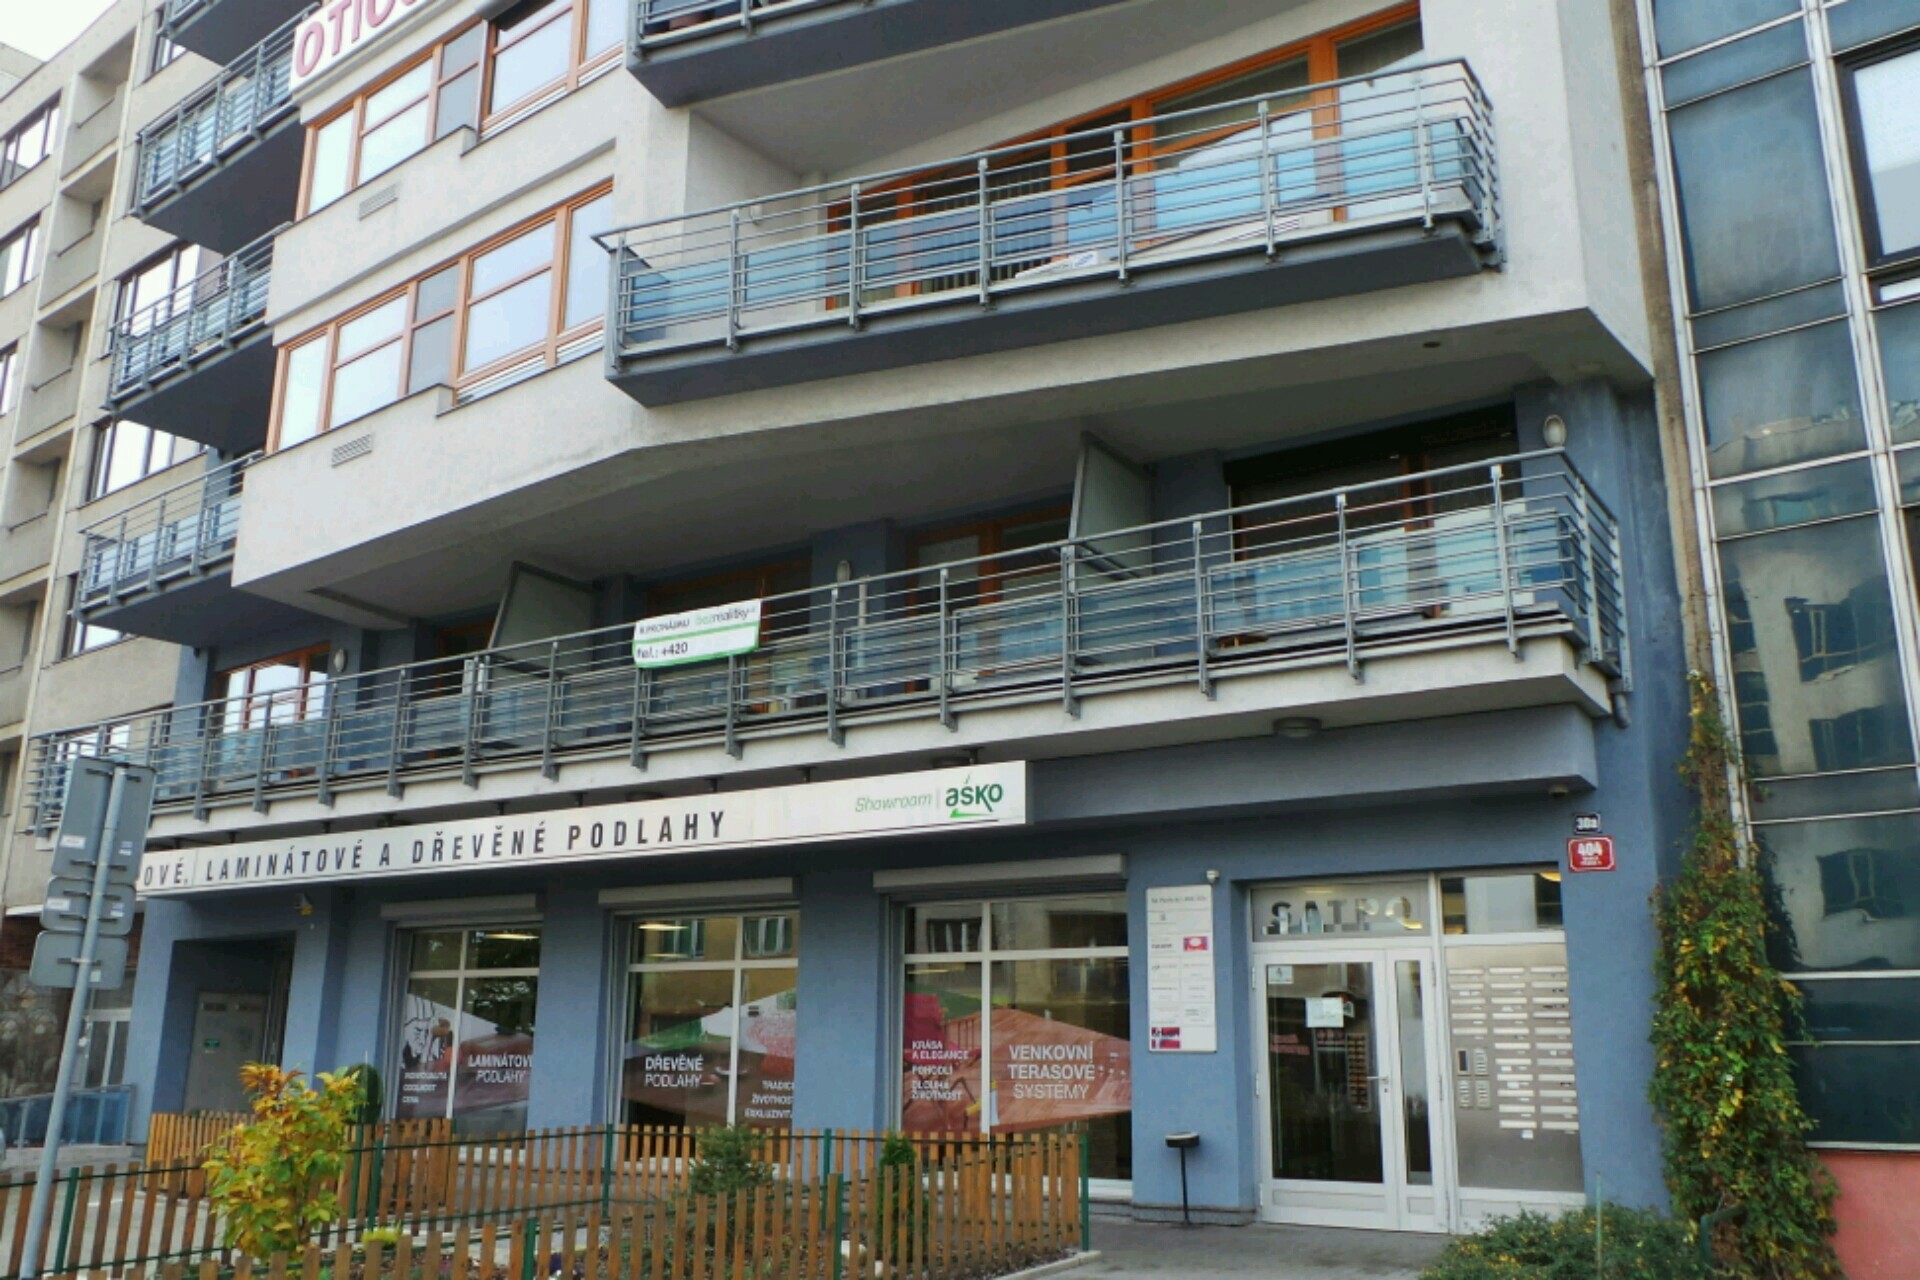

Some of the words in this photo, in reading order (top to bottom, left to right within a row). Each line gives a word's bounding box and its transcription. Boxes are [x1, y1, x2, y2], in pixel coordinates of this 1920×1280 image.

[662, 642, 689, 657] +420
[206, 839, 363, 882] LAMINÁTOVÉ
[379, 843, 391, 866] A
[412, 819, 546, 864] DŘEVĚNÉ
[567, 810, 725, 851] PODLAHY
[855, 793, 933, 813] Showroom
[1009, 1041, 1094, 1061] VENKOVNÍ
[645, 1054, 704, 1072] DŘEVĚNÉ
[1007, 1061, 1095, 1080] TERASOVÉ
[475, 1069, 526, 1084] PODLAHY
[644, 1073, 703, 1088] PODLAHY
[1013, 1080, 1090, 1100] SYSTÉMY
